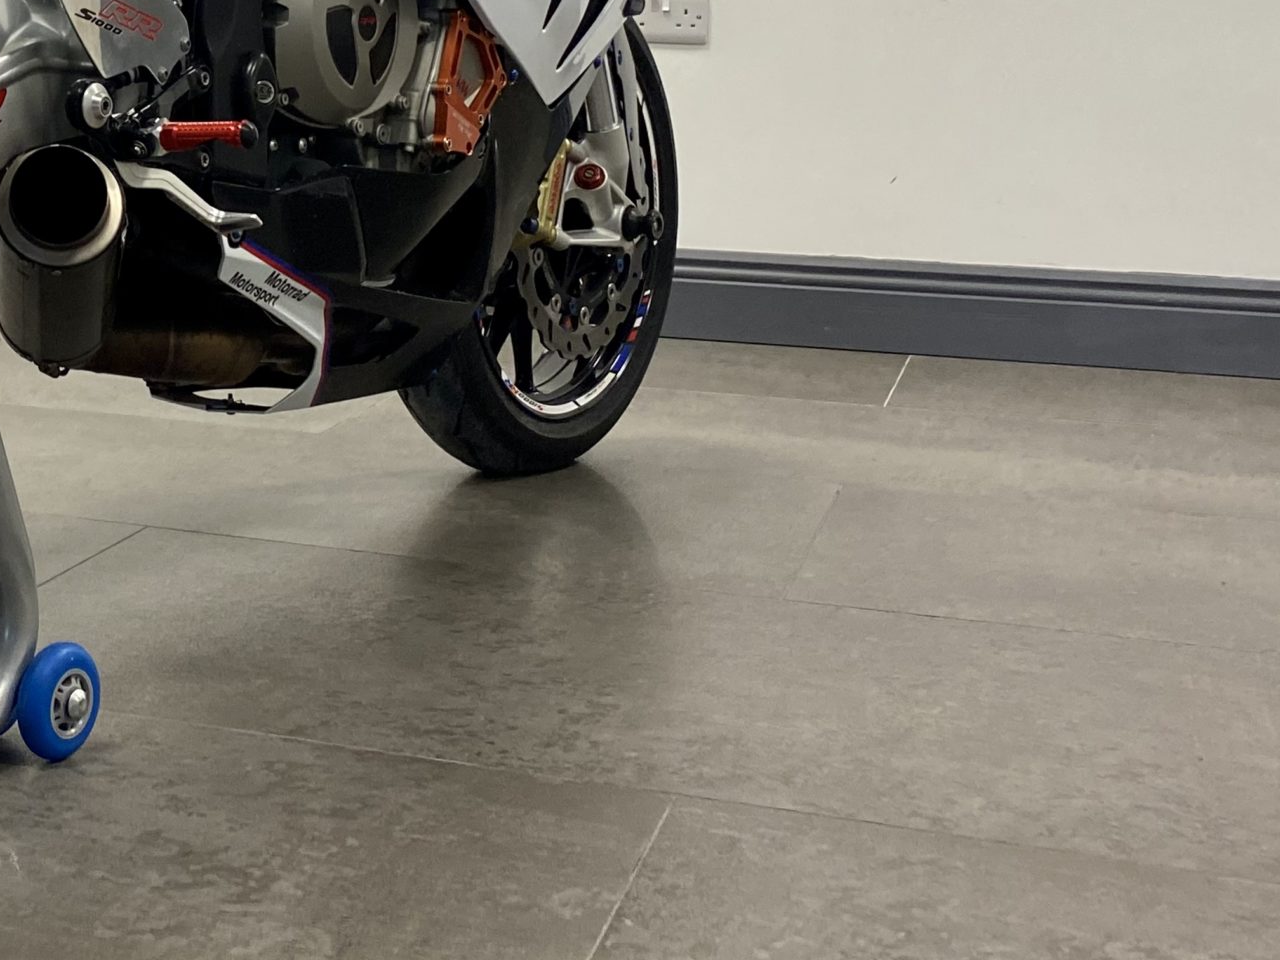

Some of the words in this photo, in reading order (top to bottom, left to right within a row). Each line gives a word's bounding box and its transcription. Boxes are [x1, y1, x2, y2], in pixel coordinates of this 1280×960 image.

[74, 8, 122, 35] S1000
[228, 271, 280, 306] Motorsport
[264, 270, 311, 302] Motorrad
